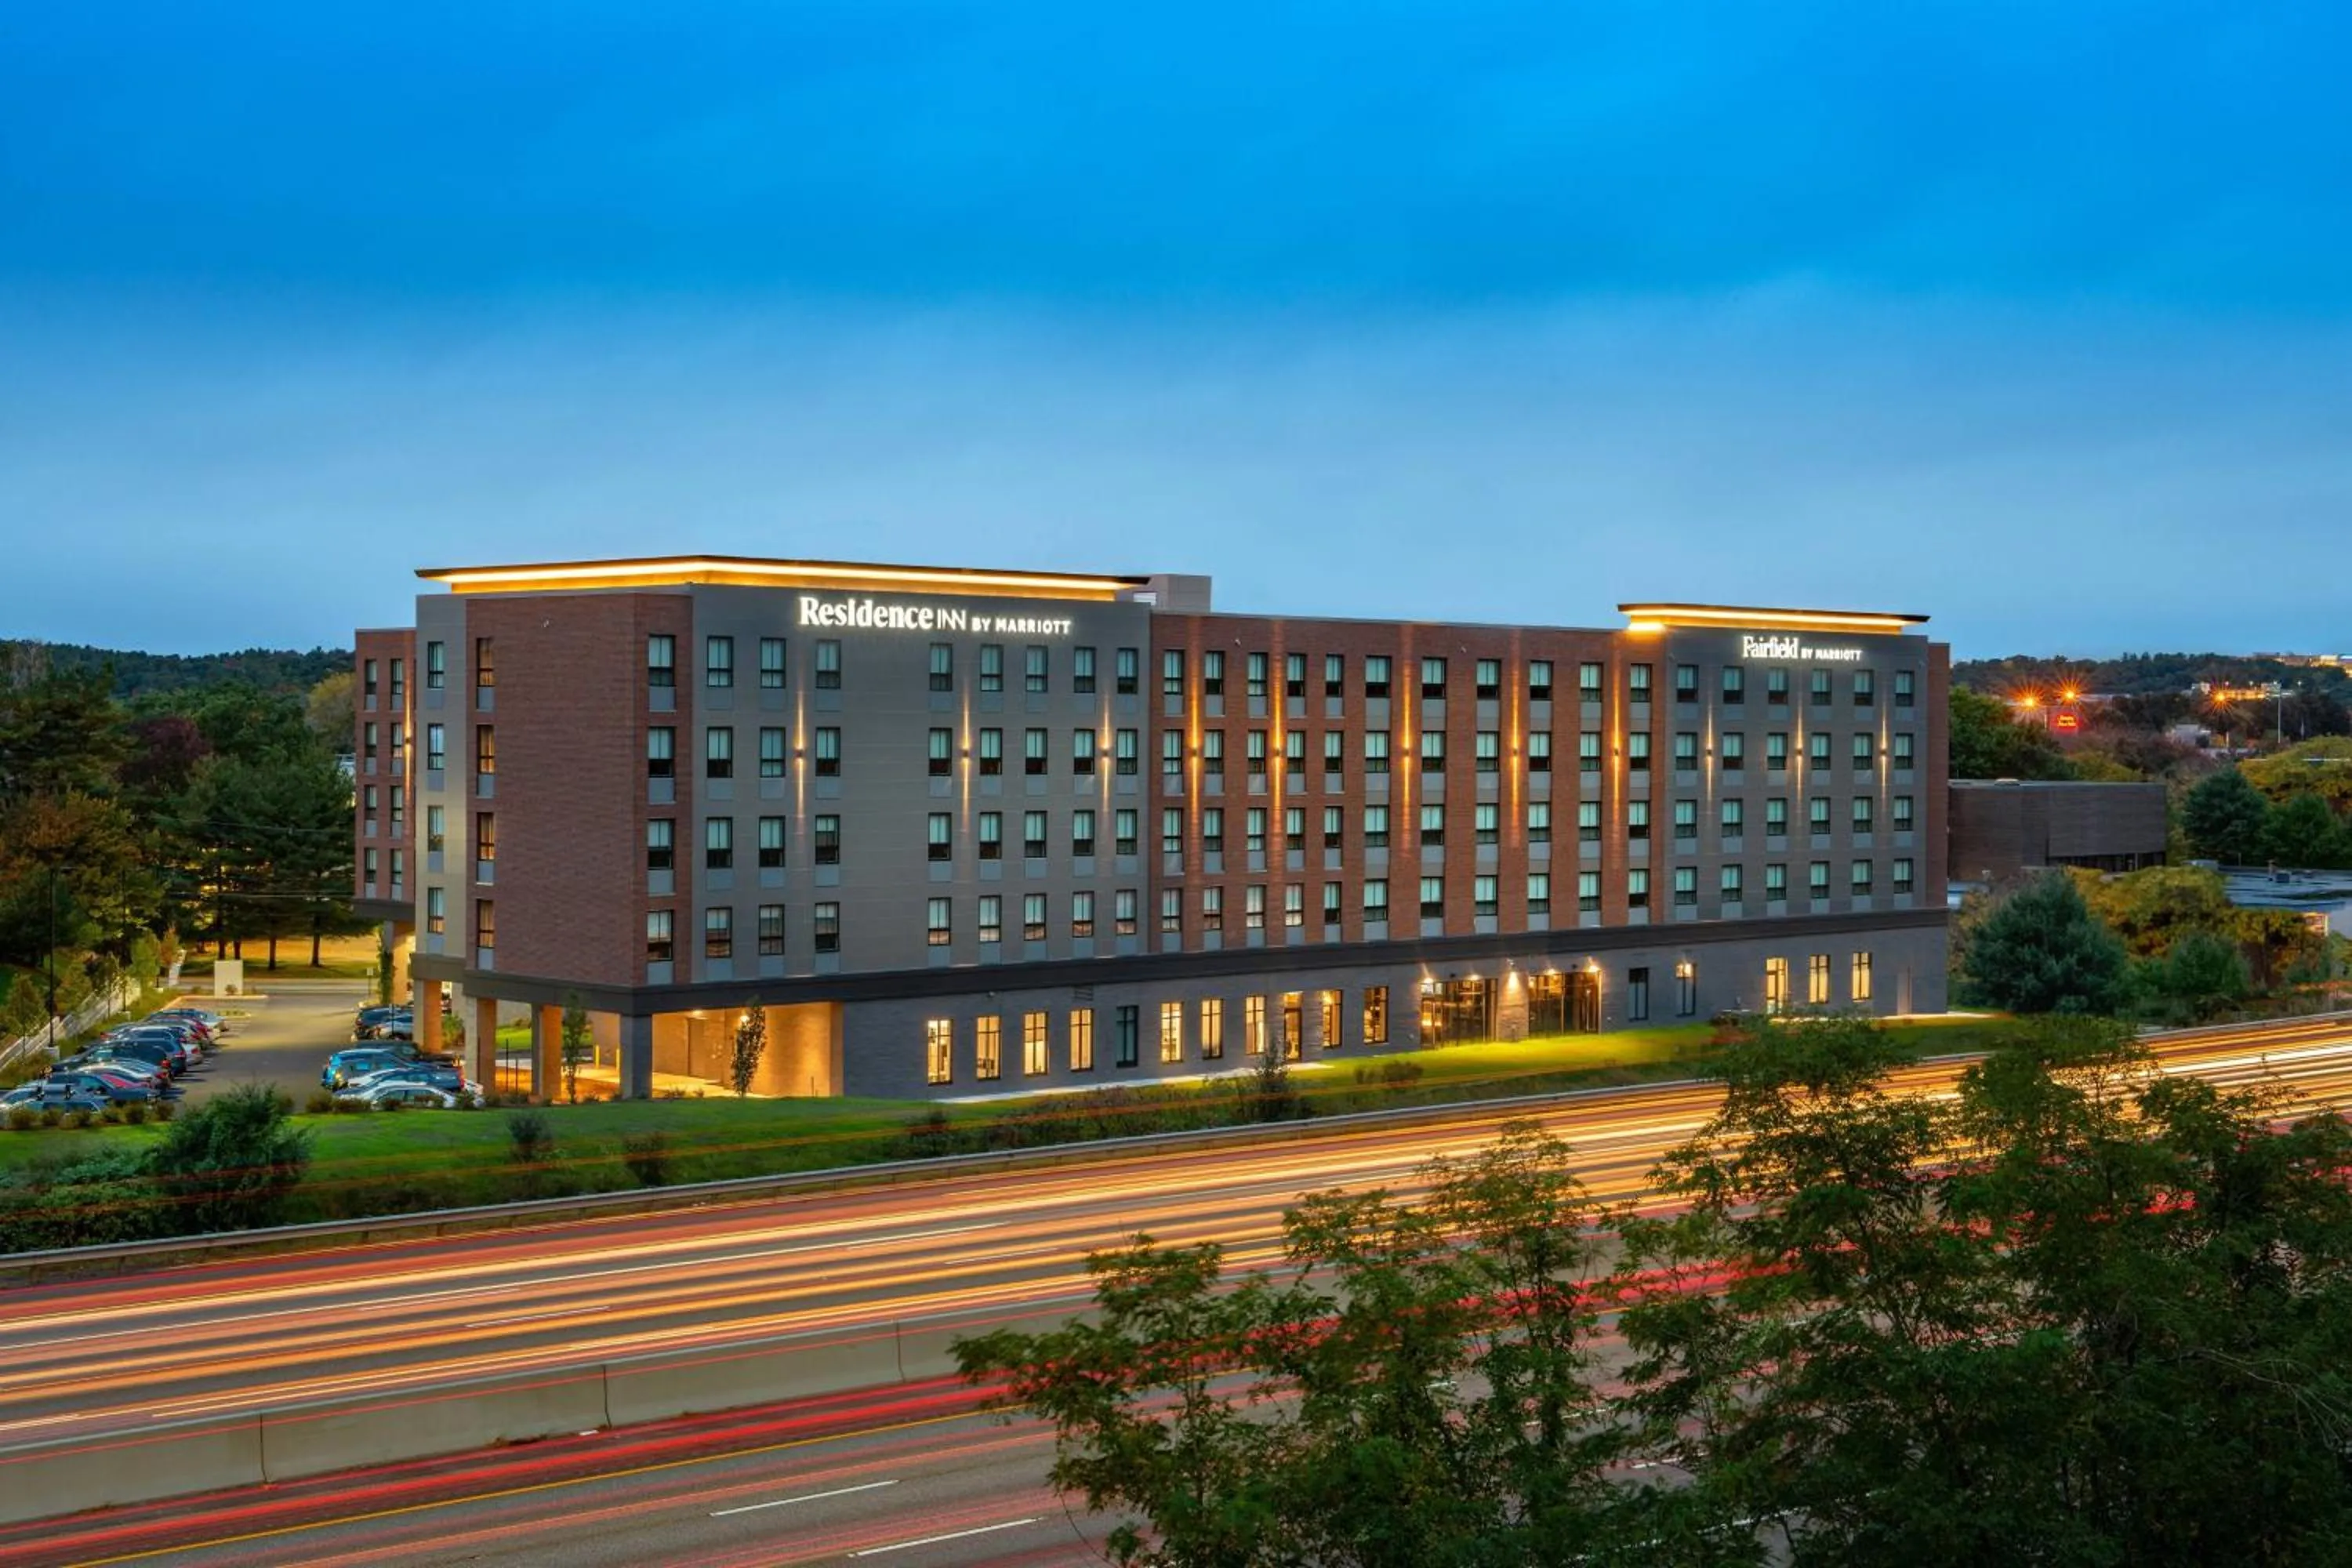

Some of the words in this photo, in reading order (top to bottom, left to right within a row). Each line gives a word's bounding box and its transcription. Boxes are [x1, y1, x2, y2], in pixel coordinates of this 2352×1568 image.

[799, 597, 933, 629] Residence
[936, 608, 967, 630] INN
[971, 617, 991, 633] BY
[995, 619, 1072, 634] MARRIOTT
[1742, 636, 1798, 659] Fairfield
[1801, 647, 1813, 659] BY
[1815, 649, 1862, 661] MARRIOTT
